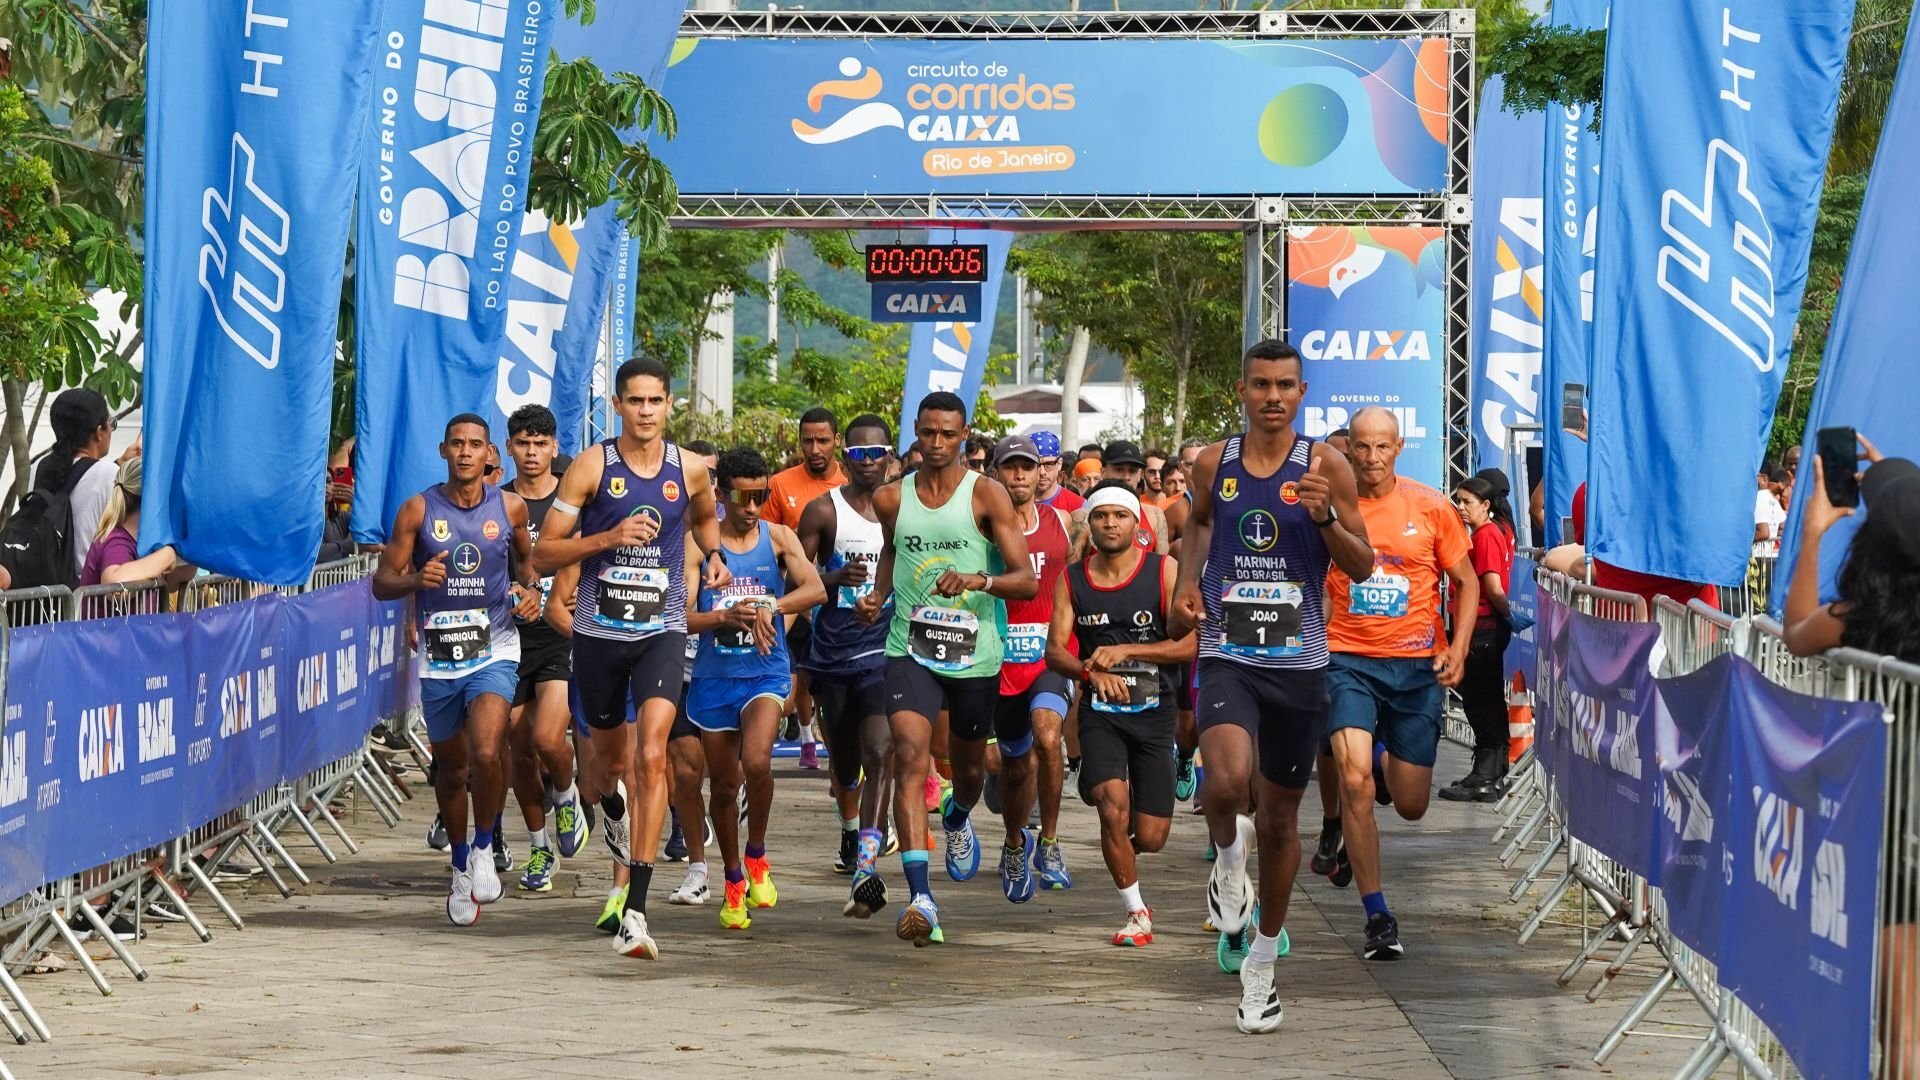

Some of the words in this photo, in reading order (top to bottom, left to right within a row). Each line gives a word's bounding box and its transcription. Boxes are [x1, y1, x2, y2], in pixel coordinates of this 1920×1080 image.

[386, 31, 405, 70] DO
[514, 1, 542, 114] BRASILEIRO
[907, 61, 979, 77] circuito
[983, 61, 1009, 77] de
[907, 72, 1076, 111] corridas
[907, 115, 1021, 142] CAIXA
[379, 87, 398, 225] GOVERNO
[505, 121, 525, 175] POVO
[931, 151, 963, 171] Rio
[968, 151, 993, 169] de
[997, 148, 1068, 168] Janeiro
[499, 184, 516, 212] DO
[491, 219, 511, 272] LADO
[870, 248, 981, 274] 00:00:06
[485, 280, 501, 308] DO
[616, 283, 626, 315] POVO
[886, 293, 967, 314] CAIXA
[615, 319, 625, 335] DO
[1300, 329, 1431, 361] CAIXA
[615, 340, 625, 368] ADO
[1330, 394, 1381, 403] GOVERNO
[1385, 394, 1400, 403] DO
[1304, 406, 1427, 438] BRIL
[616, 545, 661, 557] MARINHA
[923, 539, 969, 551] TRAINER
[615, 555, 627, 565] DO
[629, 556, 661, 568] BRASIL
[1234, 555, 1287, 570] MARINHA
[447, 577, 486, 588] MARINHA
[611, 570, 651, 582] CAIXA
[1236, 569, 1250, 580] DO
[1252, 569, 1288, 581] BRASIL
[1366, 576, 1394, 584] AIXA
[447, 588, 458, 596] DO
[458, 588, 485, 596] BRASIL
[607, 588, 660, 603] WILLDEBERG
[1237, 587, 1282, 599] CAIXA
[1361, 588, 1399, 604] 1057
[434, 614, 471, 625] CAIXA
[623, 604, 636, 621] 2
[923, 611, 961, 623] CAIXA
[1077, 613, 1110, 626] CAIXA
[1250, 610, 1279, 623] JOAO
[439, 630, 479, 643] HENRIQUE
[925, 629, 964, 643] GUSTAVO
[1256, 627, 1266, 645] 1
[452, 645, 464, 660] 8
[935, 644, 947, 660] 3
[1006, 638, 1041, 651] 1154
[296, 651, 329, 714] CAIXA
[138, 697, 176, 764] BRASIL
[78, 703, 125, 783] CAIXA
